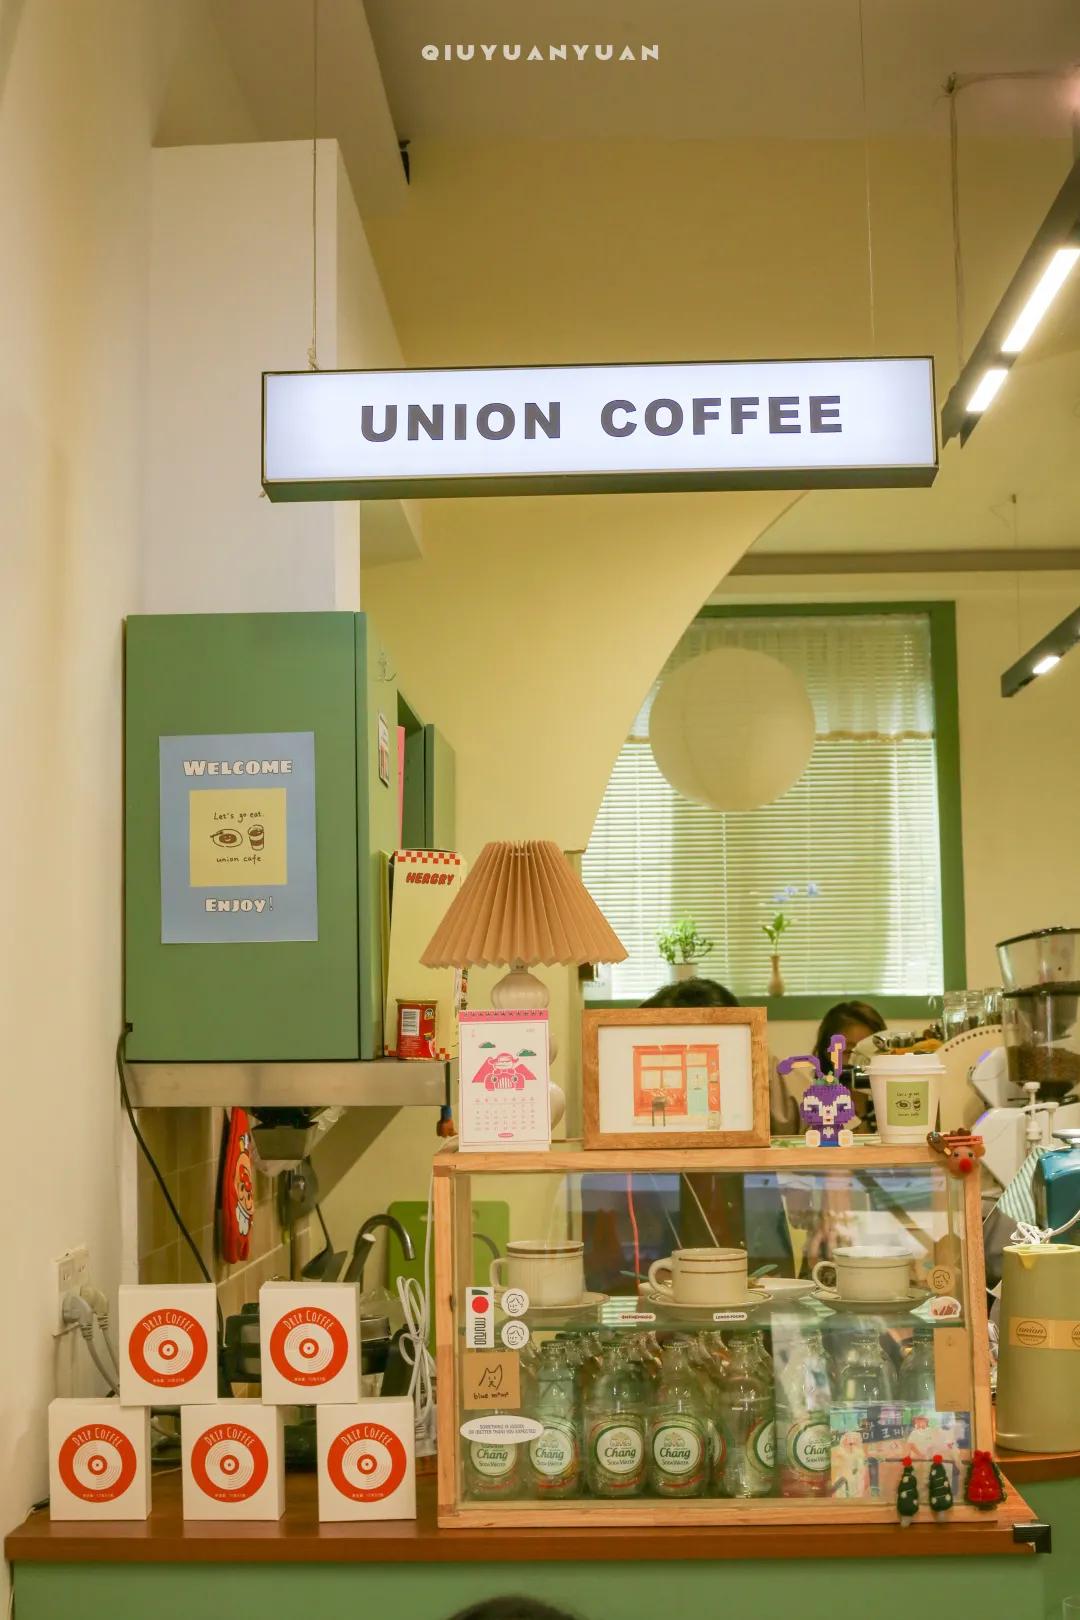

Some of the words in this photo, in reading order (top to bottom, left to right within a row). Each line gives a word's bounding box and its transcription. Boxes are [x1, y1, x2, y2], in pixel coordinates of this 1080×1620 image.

[361, 401, 561, 443] UNION
[600, 395, 843, 438] COFFEE
[183, 760, 293, 776] WELCOME
[214, 812, 235, 821] Let's
[238, 813, 247, 823] go
[243, 854, 262, 865] cafe
[142, 1315, 162, 1332] DRIP
[165, 1312, 194, 1332] COFFEE
[283, 1313, 303, 1330] DRIP
[306, 1310, 334, 1330] COFFEE
[72, 1430, 91, 1446] DRIP
[95, 1427, 123, 1448] COFFEE
[204, 1429, 223, 1446] DRIP
[226, 1427, 255, 1448] COFFEE
[340, 1429, 361, 1446] DRIP
[364, 1426, 393, 1446] COFFEE
[477, 1448, 509, 1461] Chang
[535, 1447, 565, 1461] Chang
[604, 1447, 637, 1458] Chang
[660, 1447, 691, 1460] Chang
